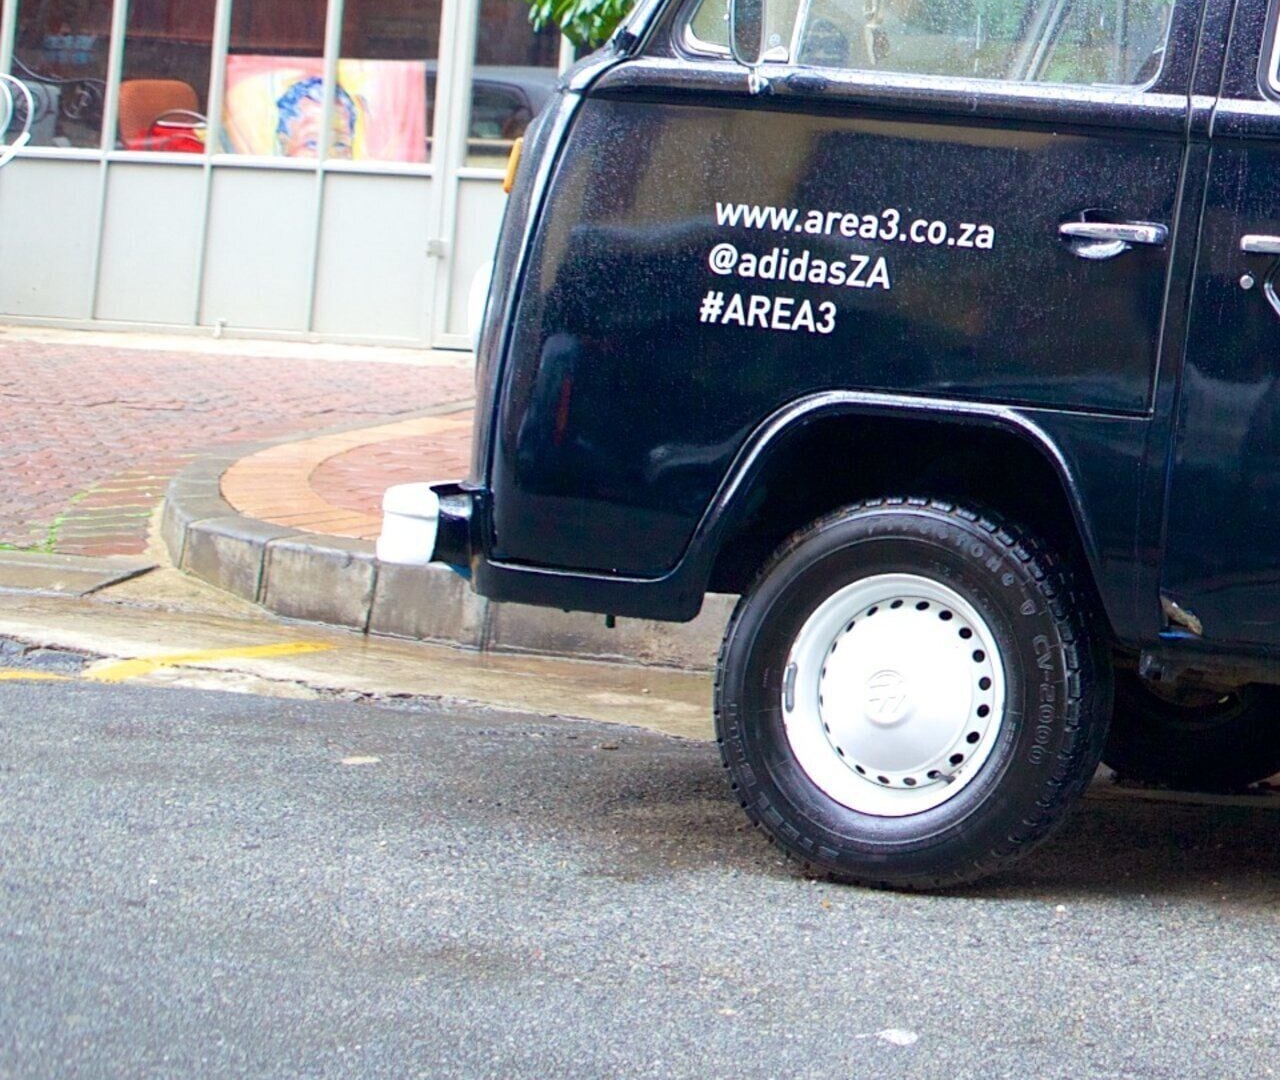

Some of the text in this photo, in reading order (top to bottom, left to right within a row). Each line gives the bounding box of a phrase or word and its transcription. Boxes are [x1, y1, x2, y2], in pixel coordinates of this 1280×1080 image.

[715, 201, 995, 250] www.area3.co.za
[708, 242, 890, 290] @adidasZA
[699, 290, 837, 334] #AREA3
